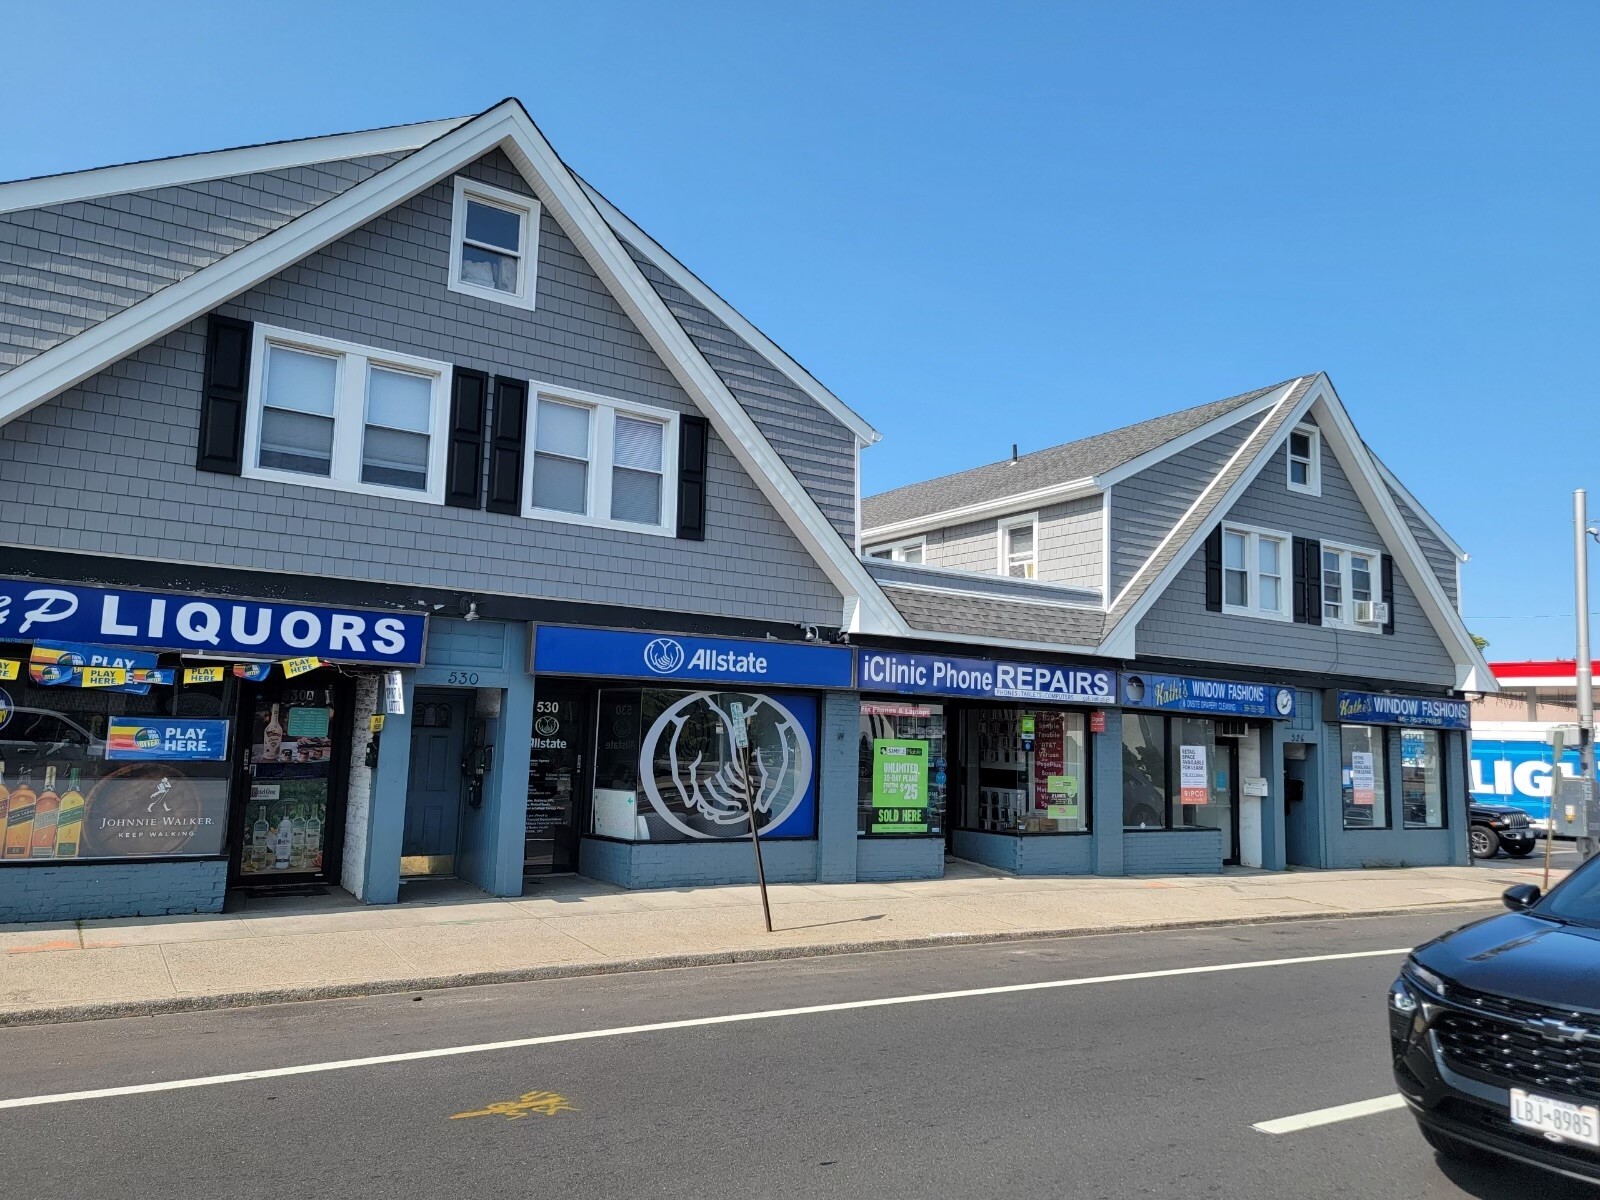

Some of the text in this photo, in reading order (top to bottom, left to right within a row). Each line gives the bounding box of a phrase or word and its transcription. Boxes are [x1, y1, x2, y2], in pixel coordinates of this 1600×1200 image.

[19, 589, 79, 633] P
[101, 595, 406, 655] LIQUORS
[91, 655, 136, 672] PLAY
[289, 658, 311, 668] PLAY
[687, 648, 768, 673] Allstate
[91, 670, 117, 678] PLAY
[191, 668, 215, 676] PLAY
[291, 664, 314, 674] HERE
[448, 671, 479, 685] 530
[864, 655, 1109, 696] iClinic Phone REPAIRS
[1154, 680, 1264, 706] Kathi's WINDOW FASHIONS
[536, 701, 559, 713] 530
[861, 705, 871, 713] Fix
[873, 706, 897, 714] Phones
[905, 709, 930, 717] Laptops
[1374, 697, 1418, 716] WINDOW
[1422, 701, 1467, 719] FASHIONS
[1039, 723, 1060, 731] Simple
[165, 728, 207, 740] PLAY
[1291, 733, 1305, 743] 526
[164, 740, 212, 752] HERE.
[1039, 750, 1060, 758] Verizon
[1036, 761, 1062, 769] PagePlus
[883, 774, 918, 783] 30-DAY PLANS
[900, 783, 918, 800] $25
[878, 809, 922, 822] SOLD HERE
[100, 818, 157, 829] JOHNNIE
[1516, 1099, 1543, 1124] LBJ
[1553, 1109, 1592, 1137] 8985
